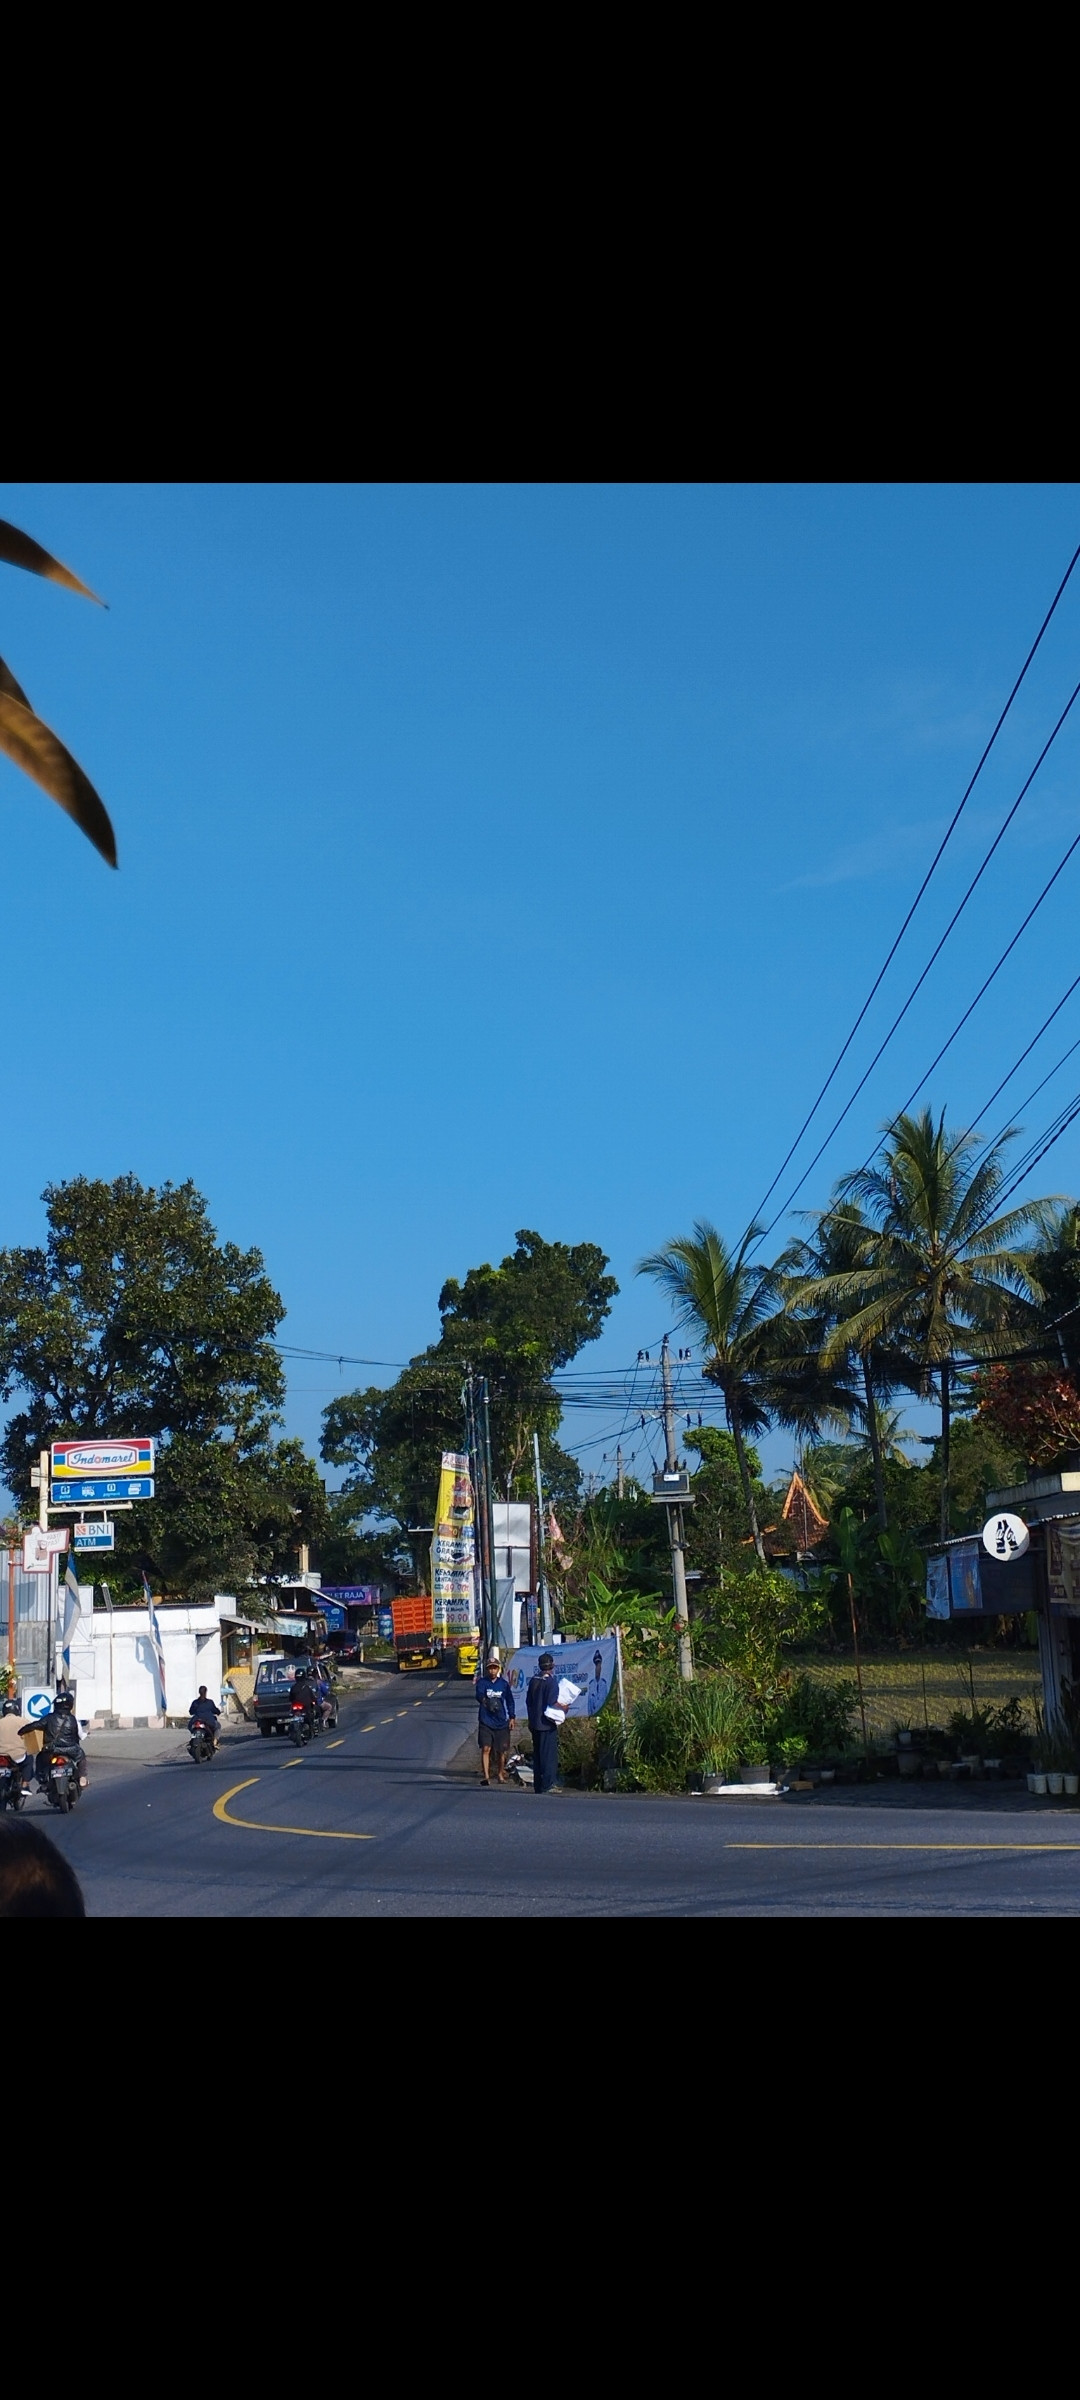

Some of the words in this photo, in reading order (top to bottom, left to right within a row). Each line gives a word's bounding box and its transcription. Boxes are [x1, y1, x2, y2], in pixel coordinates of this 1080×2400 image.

[70, 1452, 133, 1465] Indomaret
[88, 1524, 110, 1535] BNI
[76, 1537, 96, 1547] ATM
[344, 1591, 364, 1599] RAJA
[435, 1598, 465, 1606] KERAMIK
